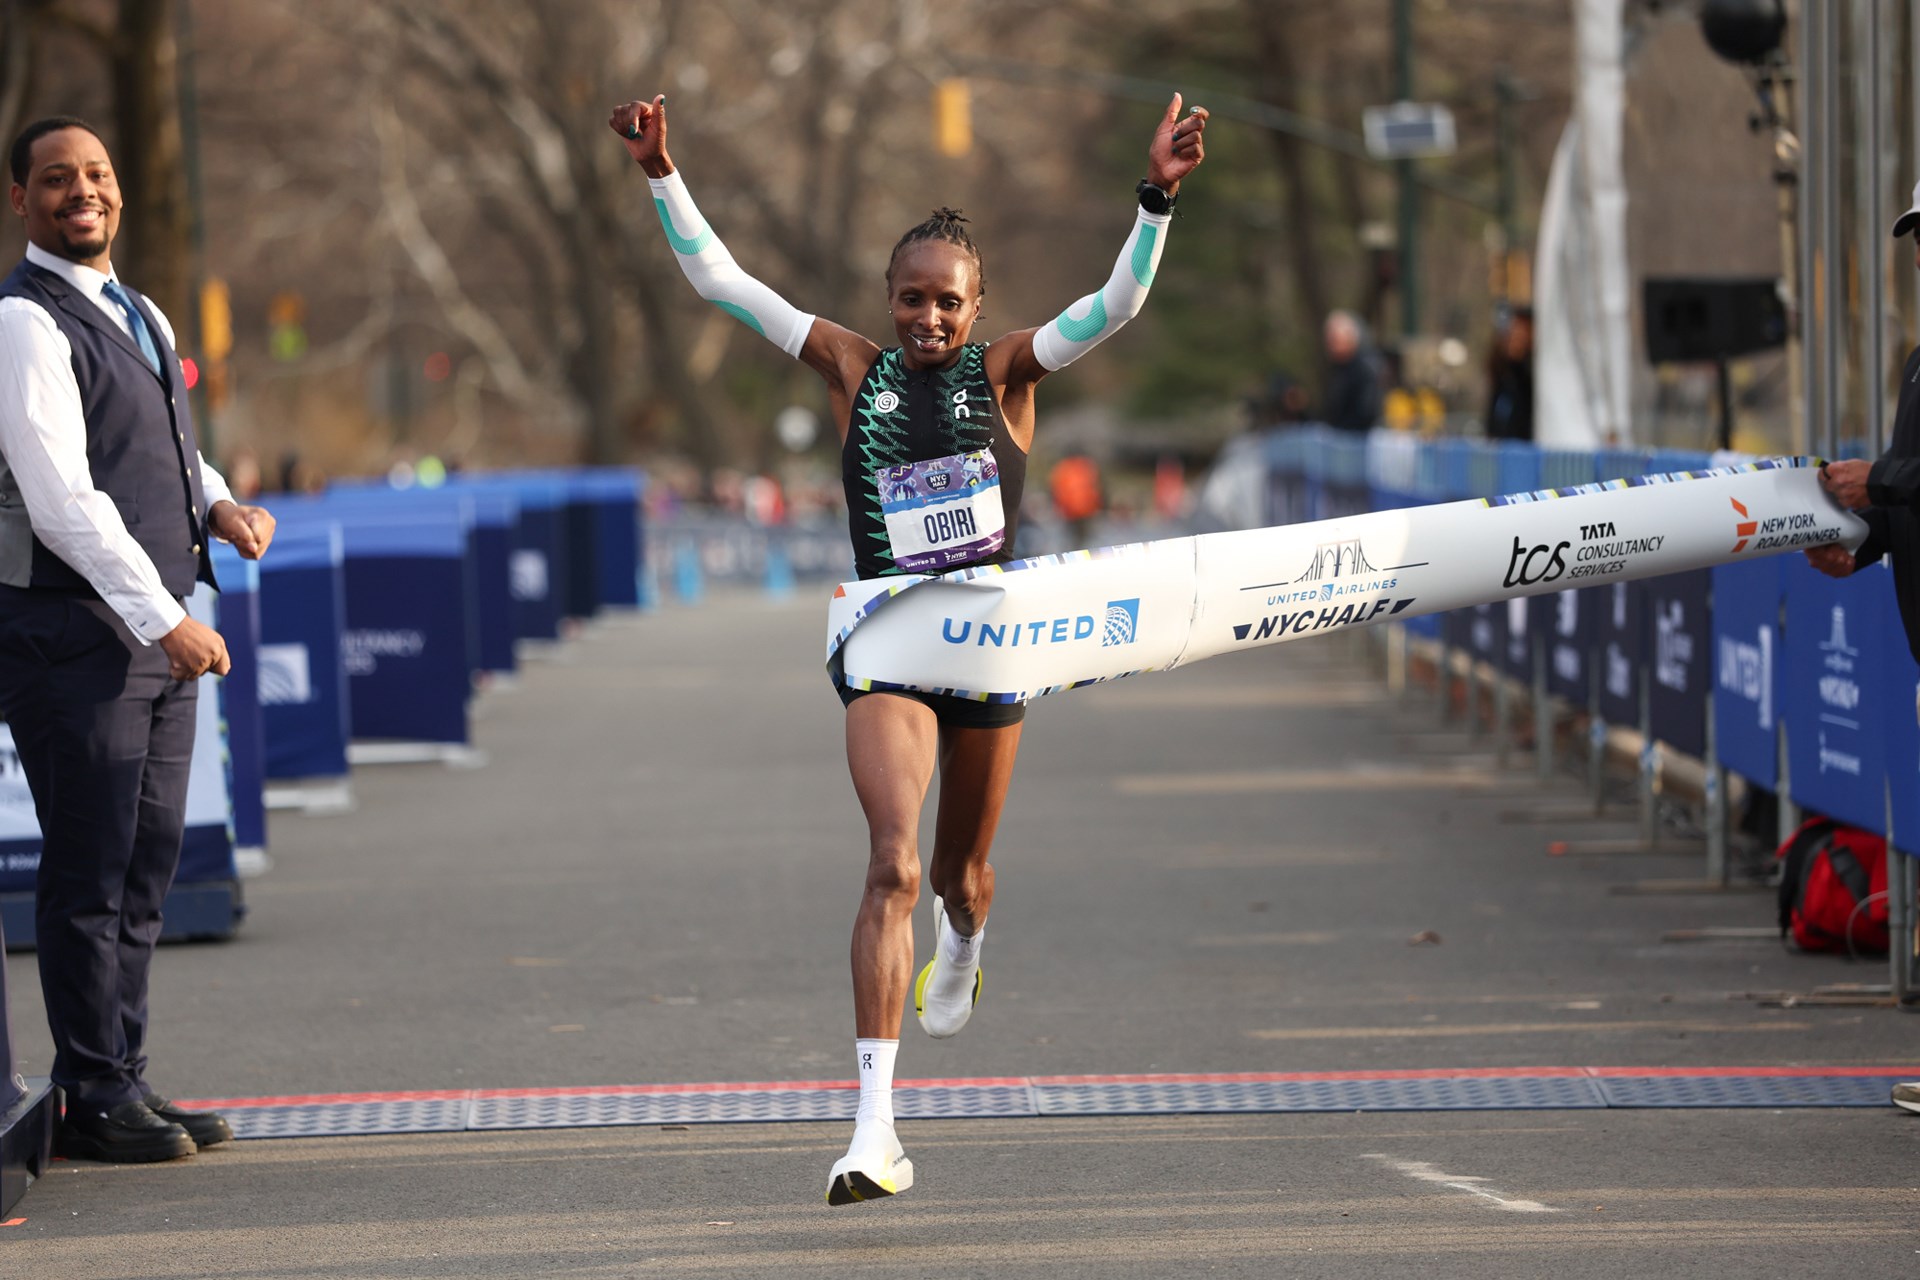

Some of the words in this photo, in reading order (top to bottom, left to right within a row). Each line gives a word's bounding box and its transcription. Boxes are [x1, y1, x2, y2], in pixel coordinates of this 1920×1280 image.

[930, 474, 947, 483] NYC
[923, 506, 977, 544] OBIRI
[1580, 522, 1616, 541] TATA
[1761, 517, 1788, 534] NEW
[1788, 513, 1817, 529] YORK
[1576, 536, 1665, 562] CONSULTANCY
[1753, 532, 1791, 550] ROAD
[1789, 527, 1841, 545] RUNNERS
[906, 559, 929, 568] UNITED
[1503, 536, 1570, 588] tcs
[1566, 560, 1626, 580] SERVICES
[1267, 590, 1317, 606] UNITED
[1335, 578, 1398, 596] AIRLINES
[943, 616, 1094, 646] UNITED
